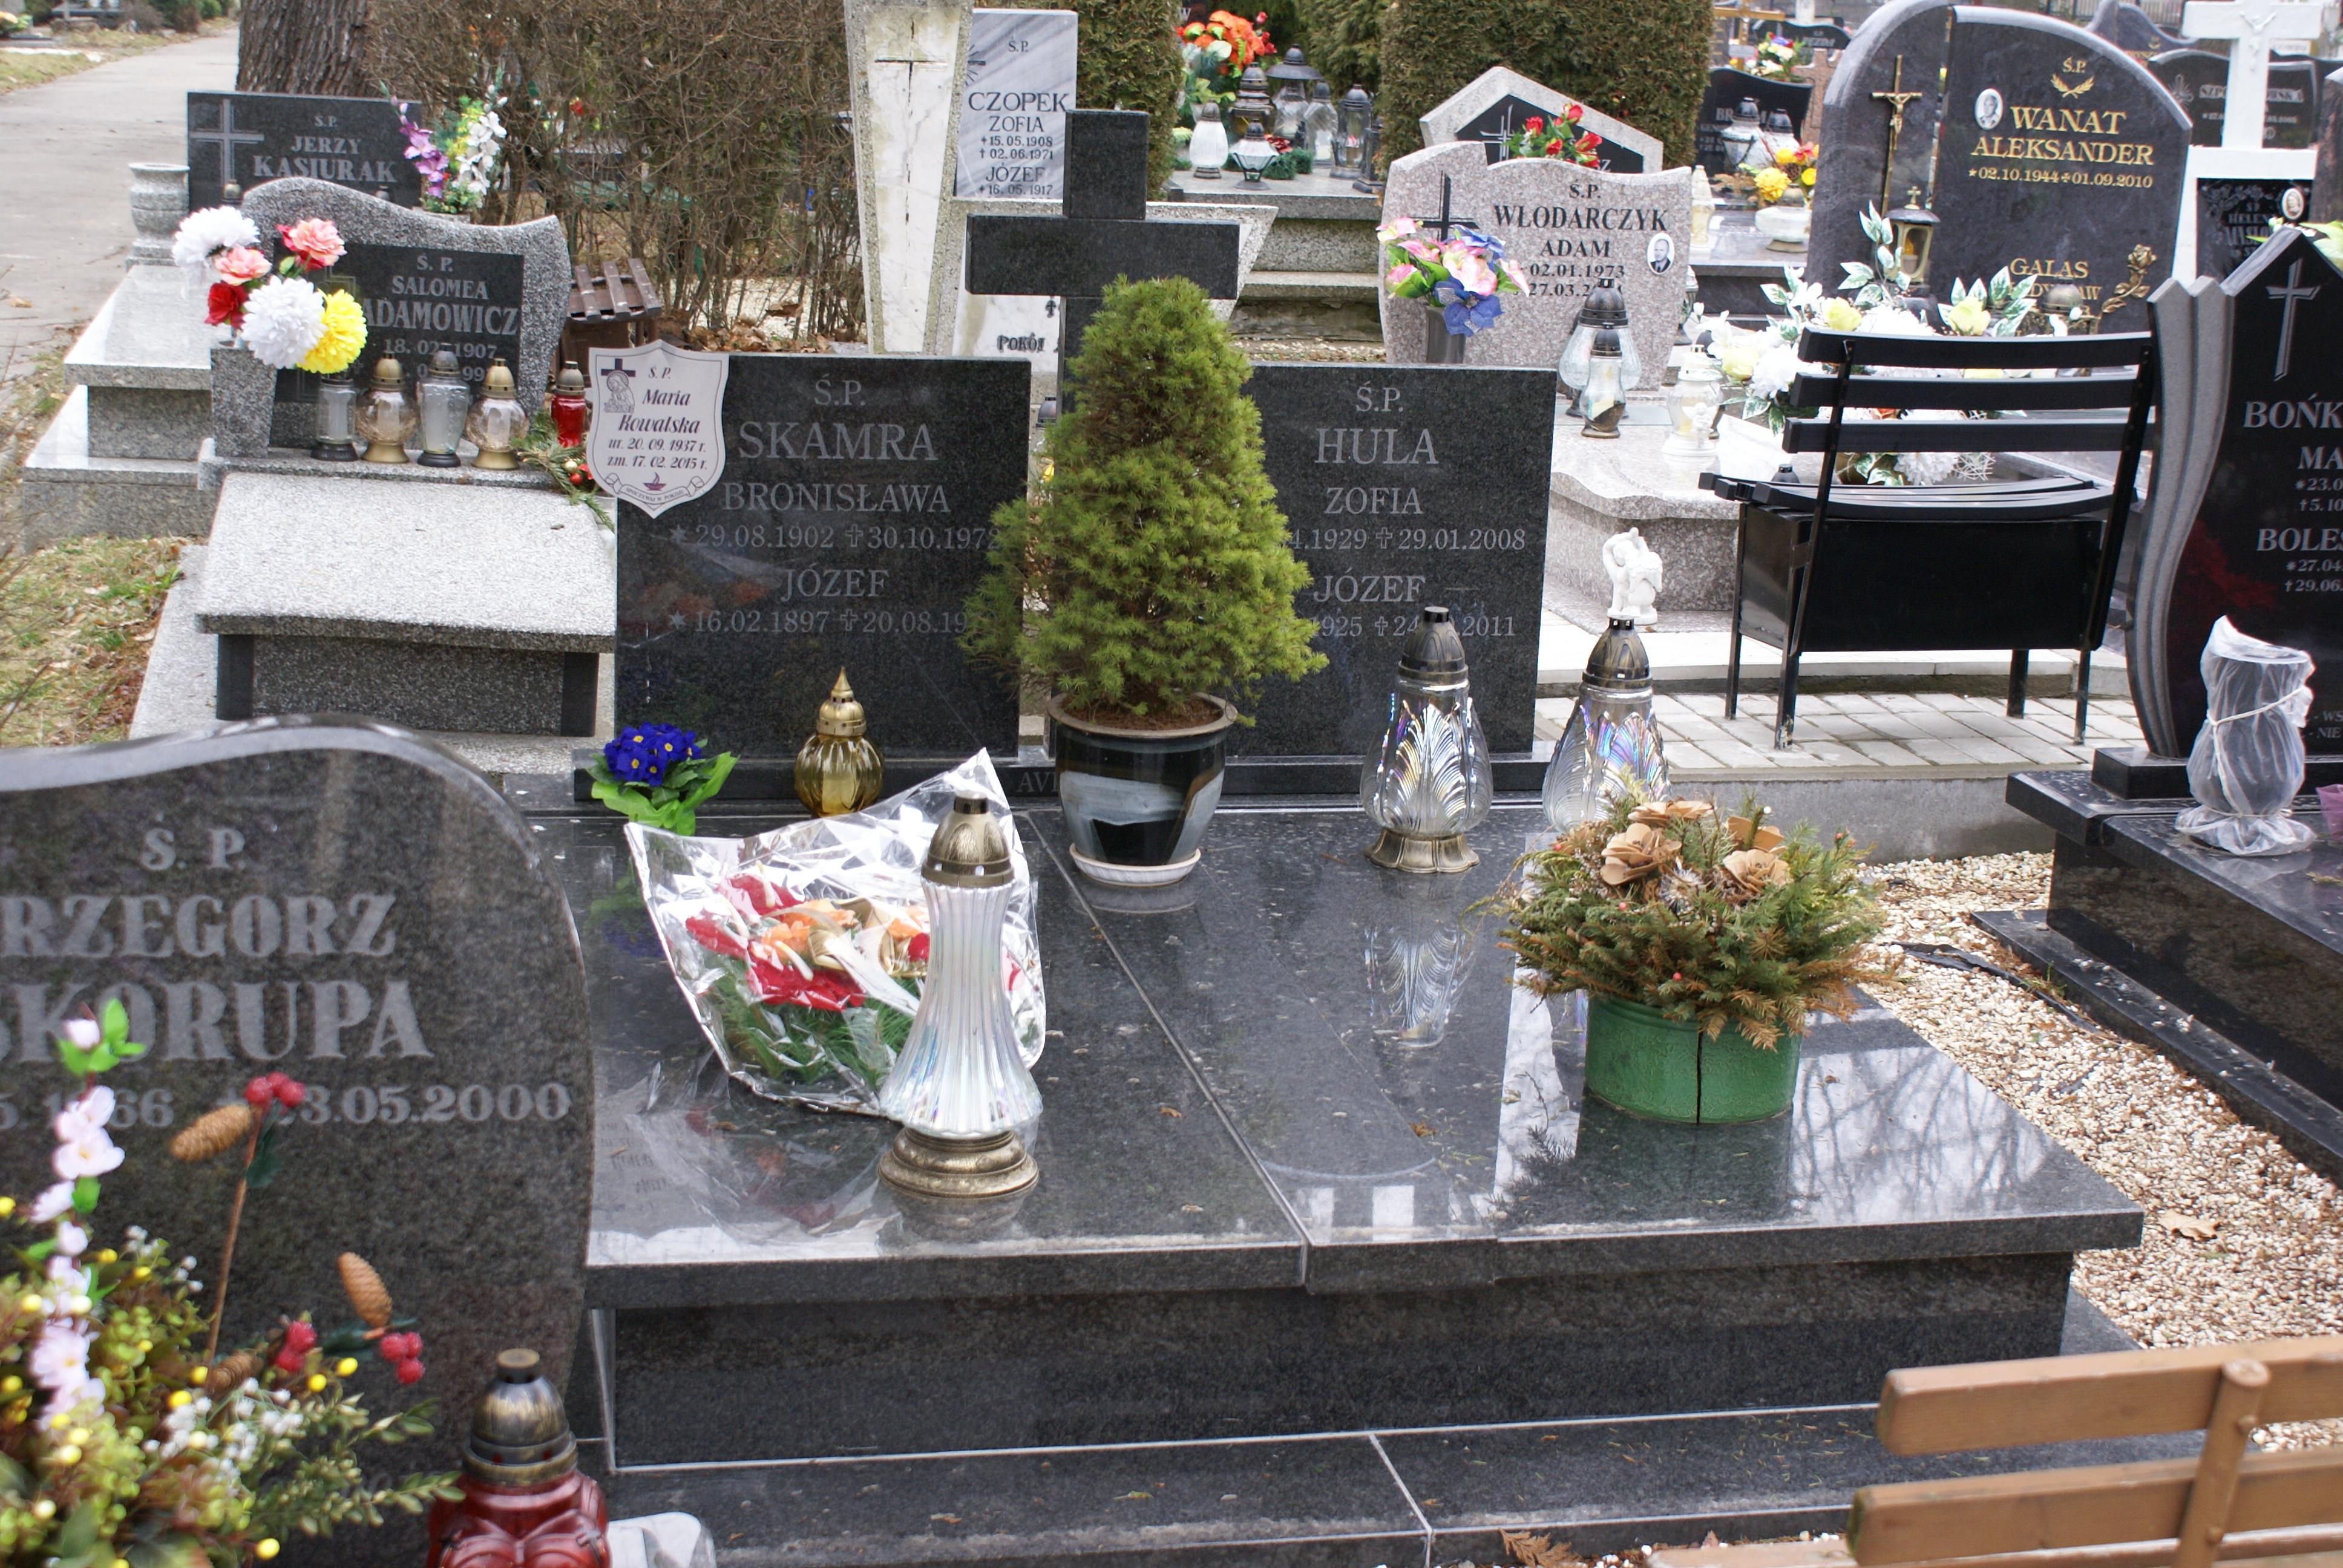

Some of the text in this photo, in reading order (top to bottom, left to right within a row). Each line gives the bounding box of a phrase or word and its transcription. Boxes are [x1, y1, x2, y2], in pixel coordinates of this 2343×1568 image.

[968, 92, 1069, 113] CZOPEK
[989, 116, 1044, 132] ZOFIA
[2010, 106, 2127, 134] WANAT
[290, 136, 361, 154] JERZY
[1970, 136, 2154, 166] ALEKSANDER
[252, 155, 398, 182] KASIURAK
[986, 162, 1045, 182] JÓZEF
[1979, 167, 2153, 188] 02.10.1944 01.09.2010
[1541, 240, 1610, 258] ADAM
[1530, 263, 1625, 278] 02.01.1973
[2010, 258, 2089, 278] GALAS
[392, 276, 488, 300] SALOMEA
[363, 298, 519, 335] ADAMOWICZ
[642, 389, 690, 406] Maria
[814, 373, 865, 406] Ś.P.
[1355, 381, 1404, 413] Ś.P.
[618, 414, 701, 434] Kowalska
[609, 439, 623, 449] ur.
[628, 438, 644, 450] 20.
[649, 439, 665, 451] 09.
[669, 440, 696, 452] 1937
[739, 422, 938, 461] SKAMRA
[1314, 428, 1440, 465] HULA
[607, 457, 628, 467] zm.
[633, 456, 646, 468] 17.
[650, 457, 666, 468] 02.
[670, 457, 696, 469] 2015
[725, 482, 951, 513] BRONISŁAWA
[1324, 487, 1423, 514] ZOFIA
[696, 524, 834, 548] 29.08.1902
[1397, 529, 1525, 550] 29.01.2008
[781, 563, 889, 603] JÓZEF
[1313, 567, 1426, 603] JÓZEF
[695, 610, 830, 633] 16.02.1897
[0, 979, 434, 1064] KORUPA
